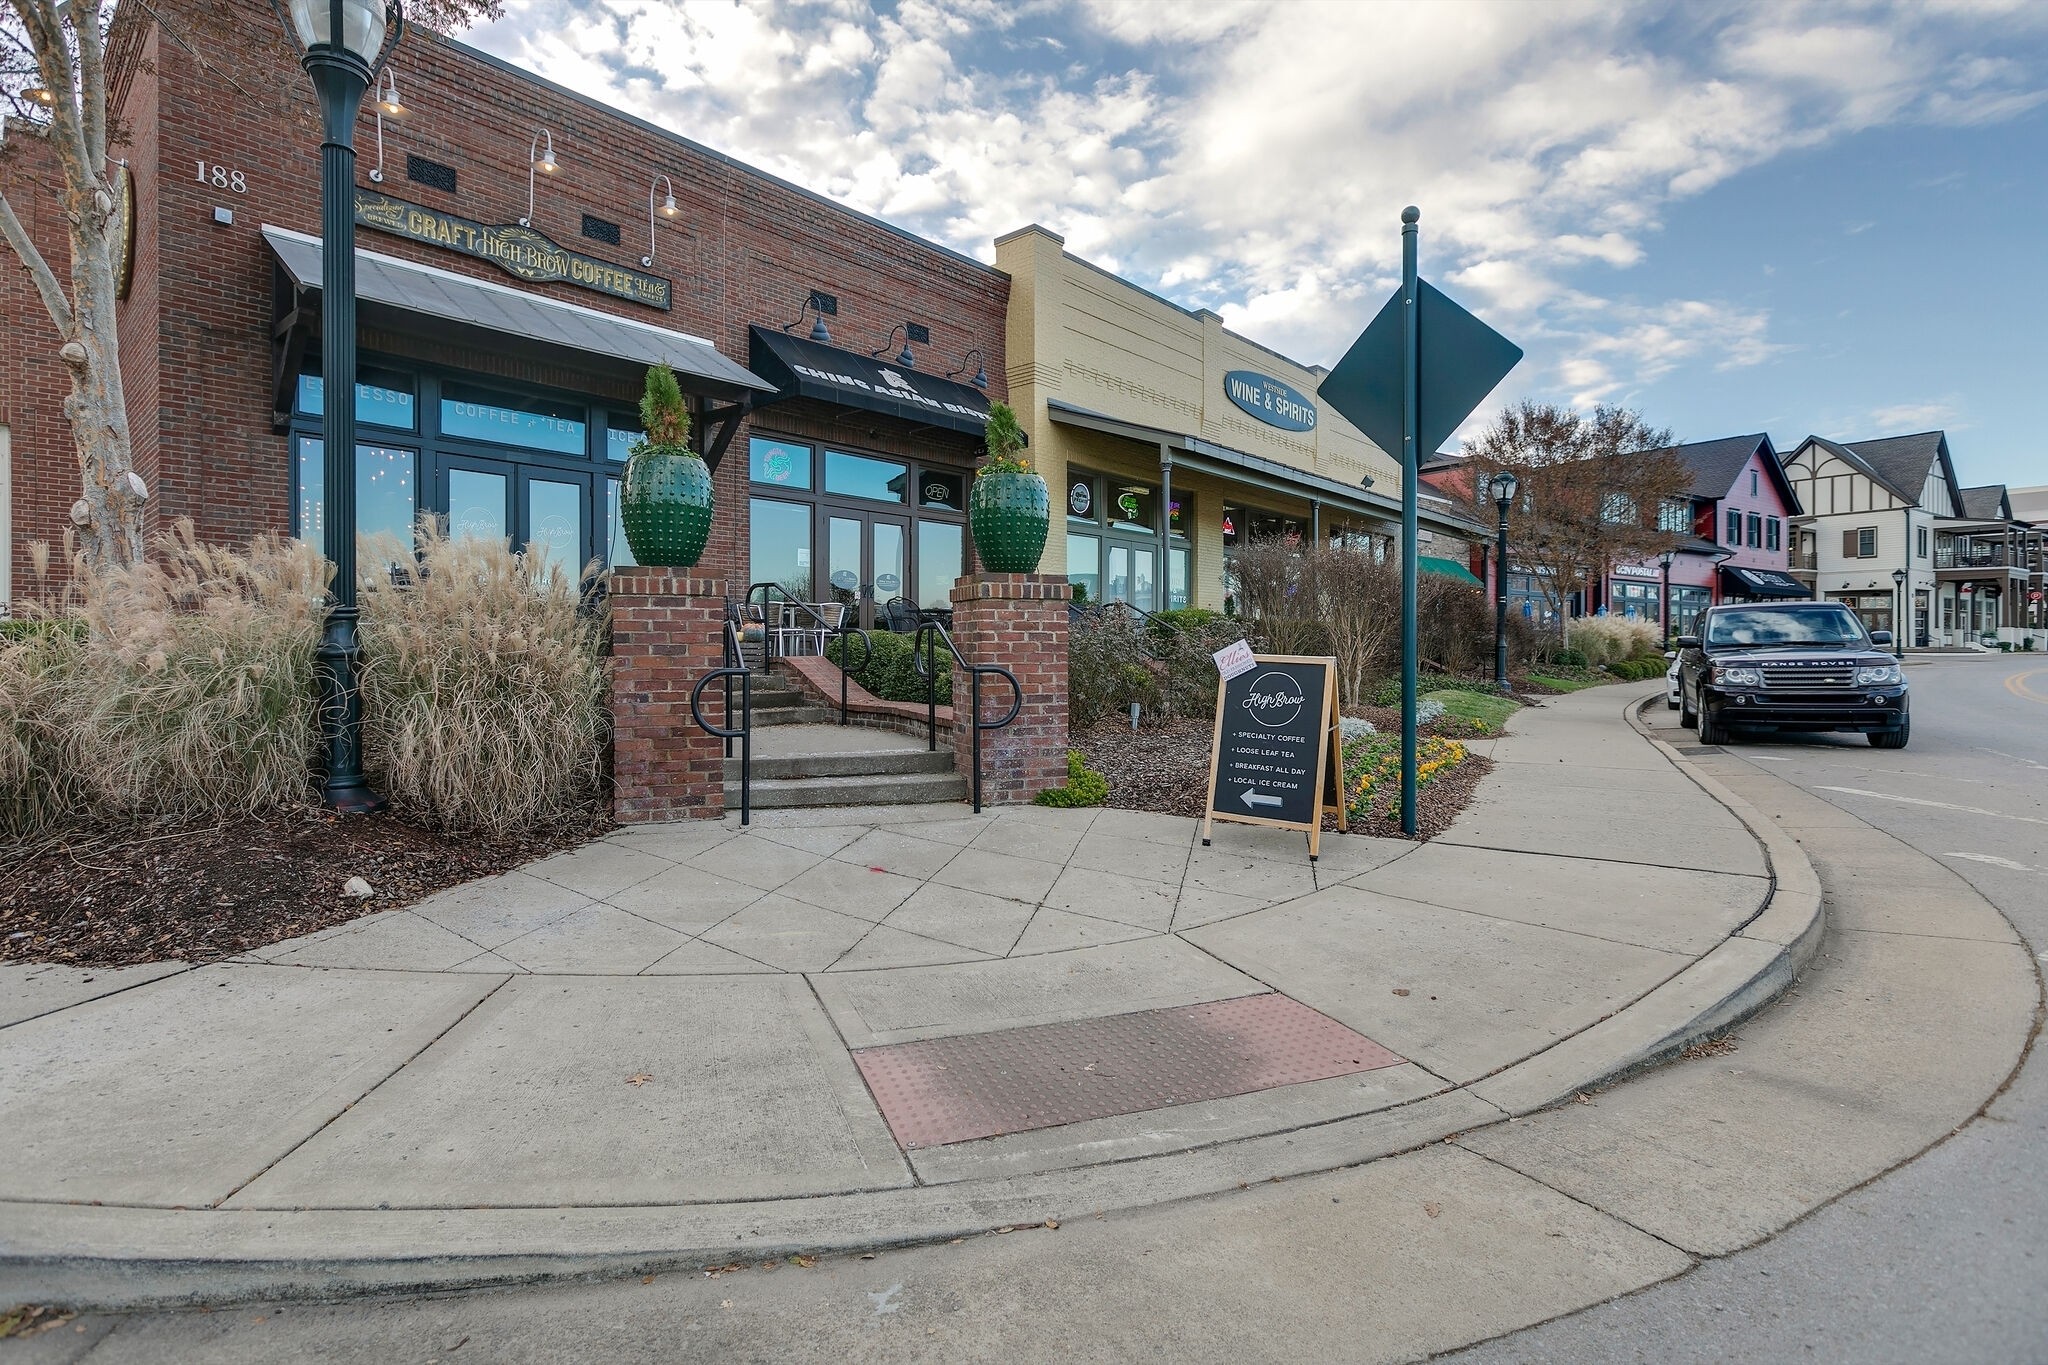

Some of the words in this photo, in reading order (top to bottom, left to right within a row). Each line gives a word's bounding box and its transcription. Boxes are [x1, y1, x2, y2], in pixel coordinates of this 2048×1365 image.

[195, 161, 247, 193] 188
[367, 213, 404, 228] BREWED
[409, 211, 477, 250] CRAFT
[478, 226, 520, 263] HIGH
[526, 244, 569, 276] BROW
[571, 258, 633, 294] COFFEE
[306, 377, 408, 405] EESSO
[793, 364, 871, 391] CHING
[874, 384, 942, 409] ASIAN
[943, 402, 992, 420] BIST
[1262, 380, 1287, 397] WESTSIDE
[1231, 378, 1260, 406] WINE
[1264, 392, 1272, 411] &
[1275, 396, 1314, 426] SPIRITS
[455, 403, 519, 425] COFFEE
[546, 418, 574, 434] TEA
[608, 430, 634, 442] ICE
[925, 485, 950, 498] OPEN
[1238, 731, 1276, 741] SPECIALTY
[1277, 735, 1306, 744] COFFEE
[1236, 747, 1259, 755] LOOSE
[1234, 762, 1273, 772] BREAKFAST
[1275, 766, 1289, 774] ALL
[1233, 777, 1256, 785] LOCAL
[1258, 779, 1271, 787] ICE
[1272, 780, 1298, 789] CREAM
